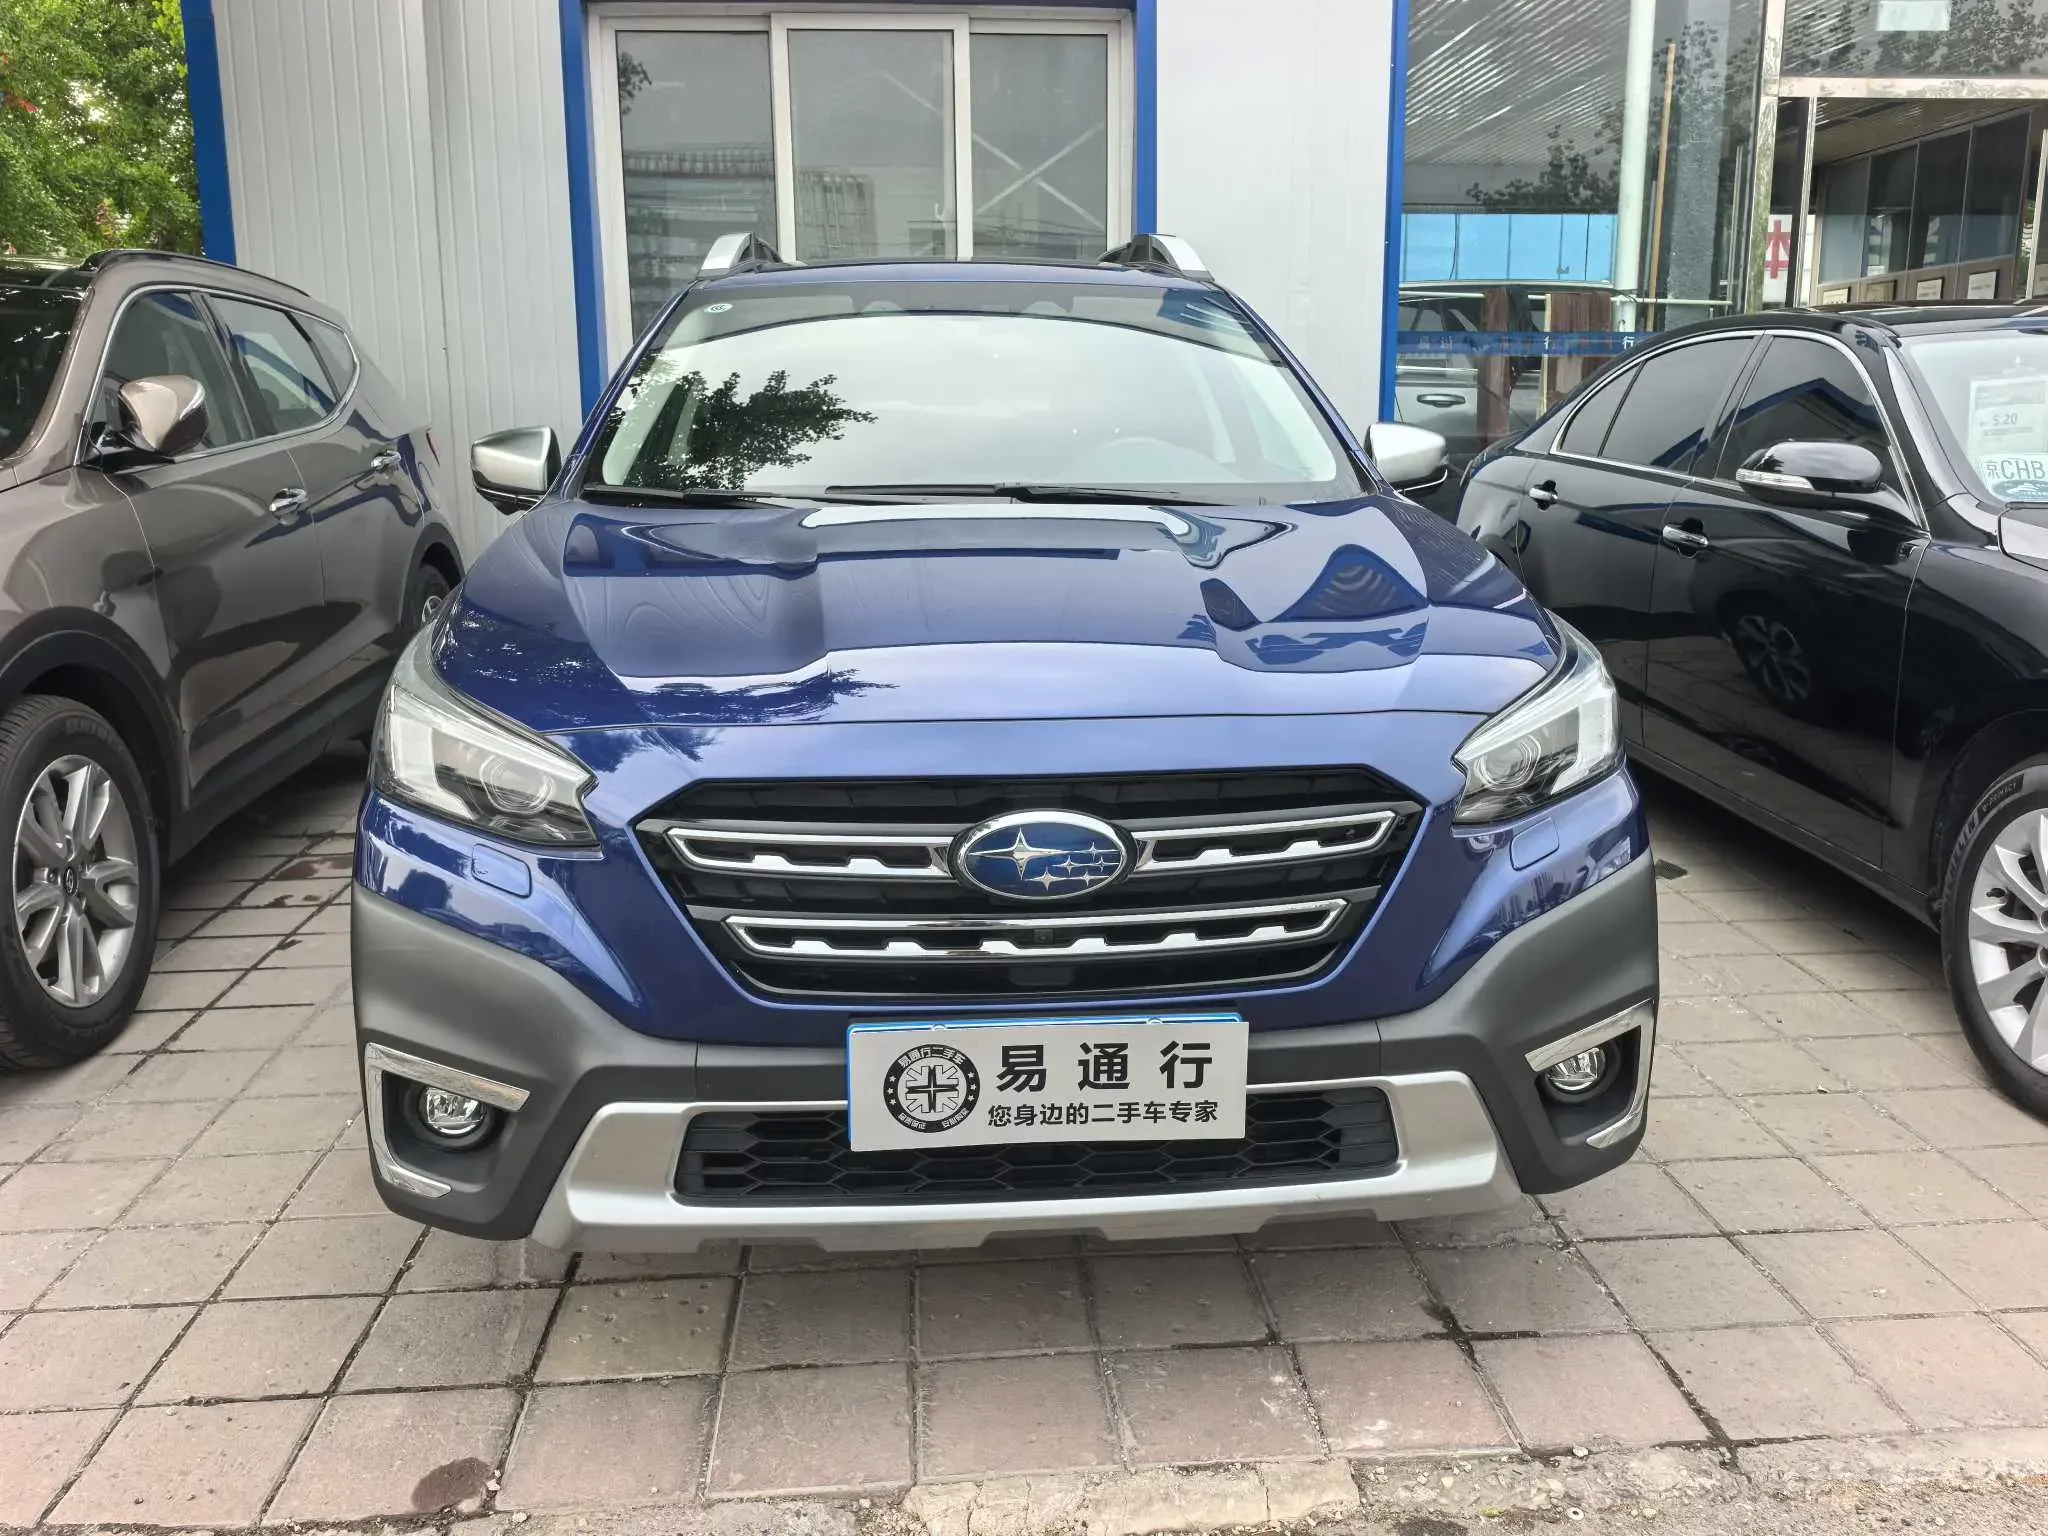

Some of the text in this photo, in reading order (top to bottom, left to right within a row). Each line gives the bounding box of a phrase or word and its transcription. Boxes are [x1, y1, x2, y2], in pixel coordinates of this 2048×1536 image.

[996, 1041, 1213, 1092] 易通行
[987, 1101, 1218, 1128] 您身边的二手车专家
